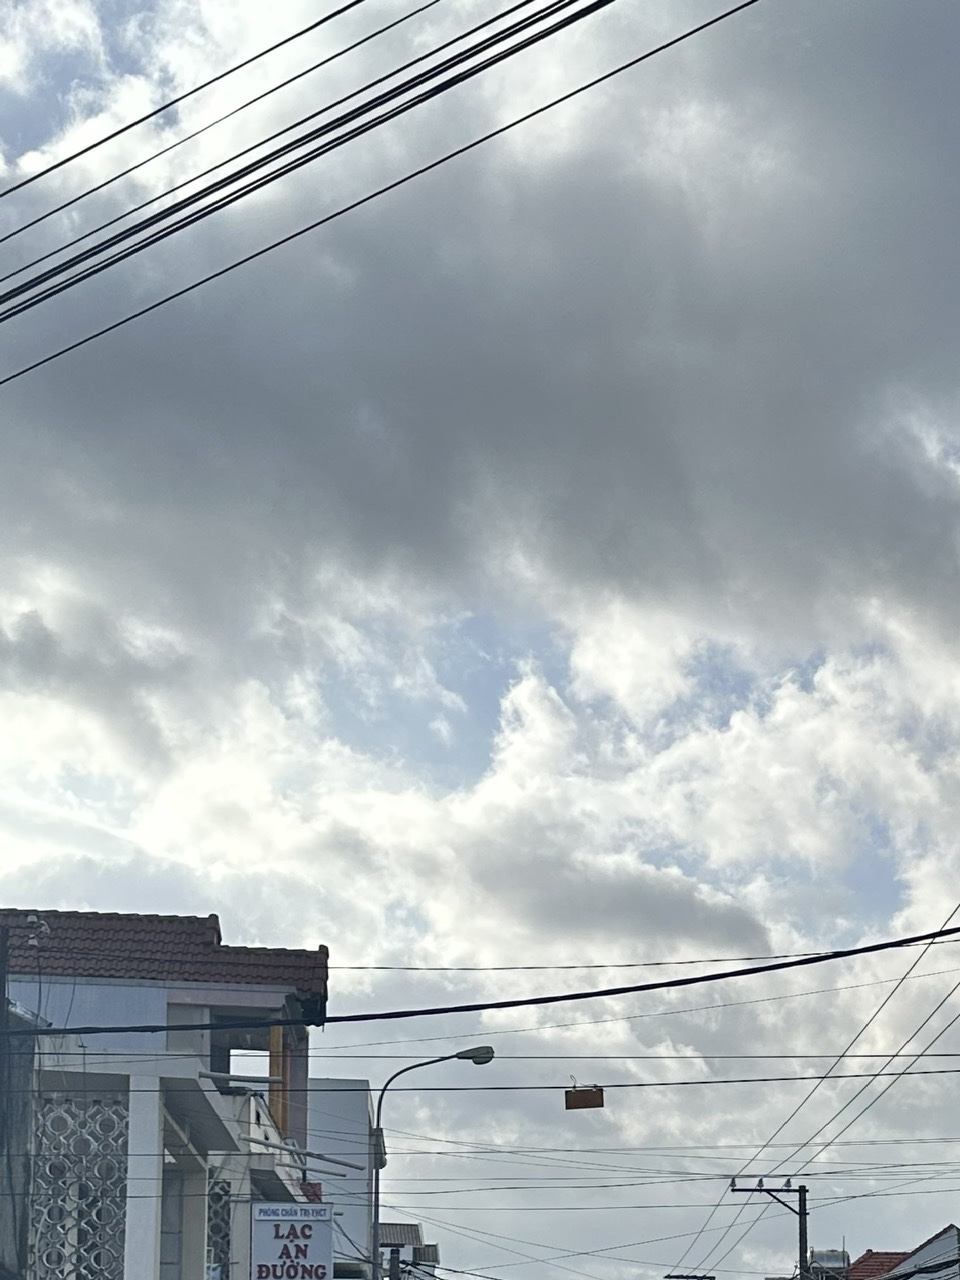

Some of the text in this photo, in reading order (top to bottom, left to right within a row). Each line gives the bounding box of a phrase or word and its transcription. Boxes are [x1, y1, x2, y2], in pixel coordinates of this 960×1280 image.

[273, 1223, 313, 1243] LẠC
[278, 1243, 308, 1259] AN
[256, 1260, 327, 1280] ĐƯỜNG
